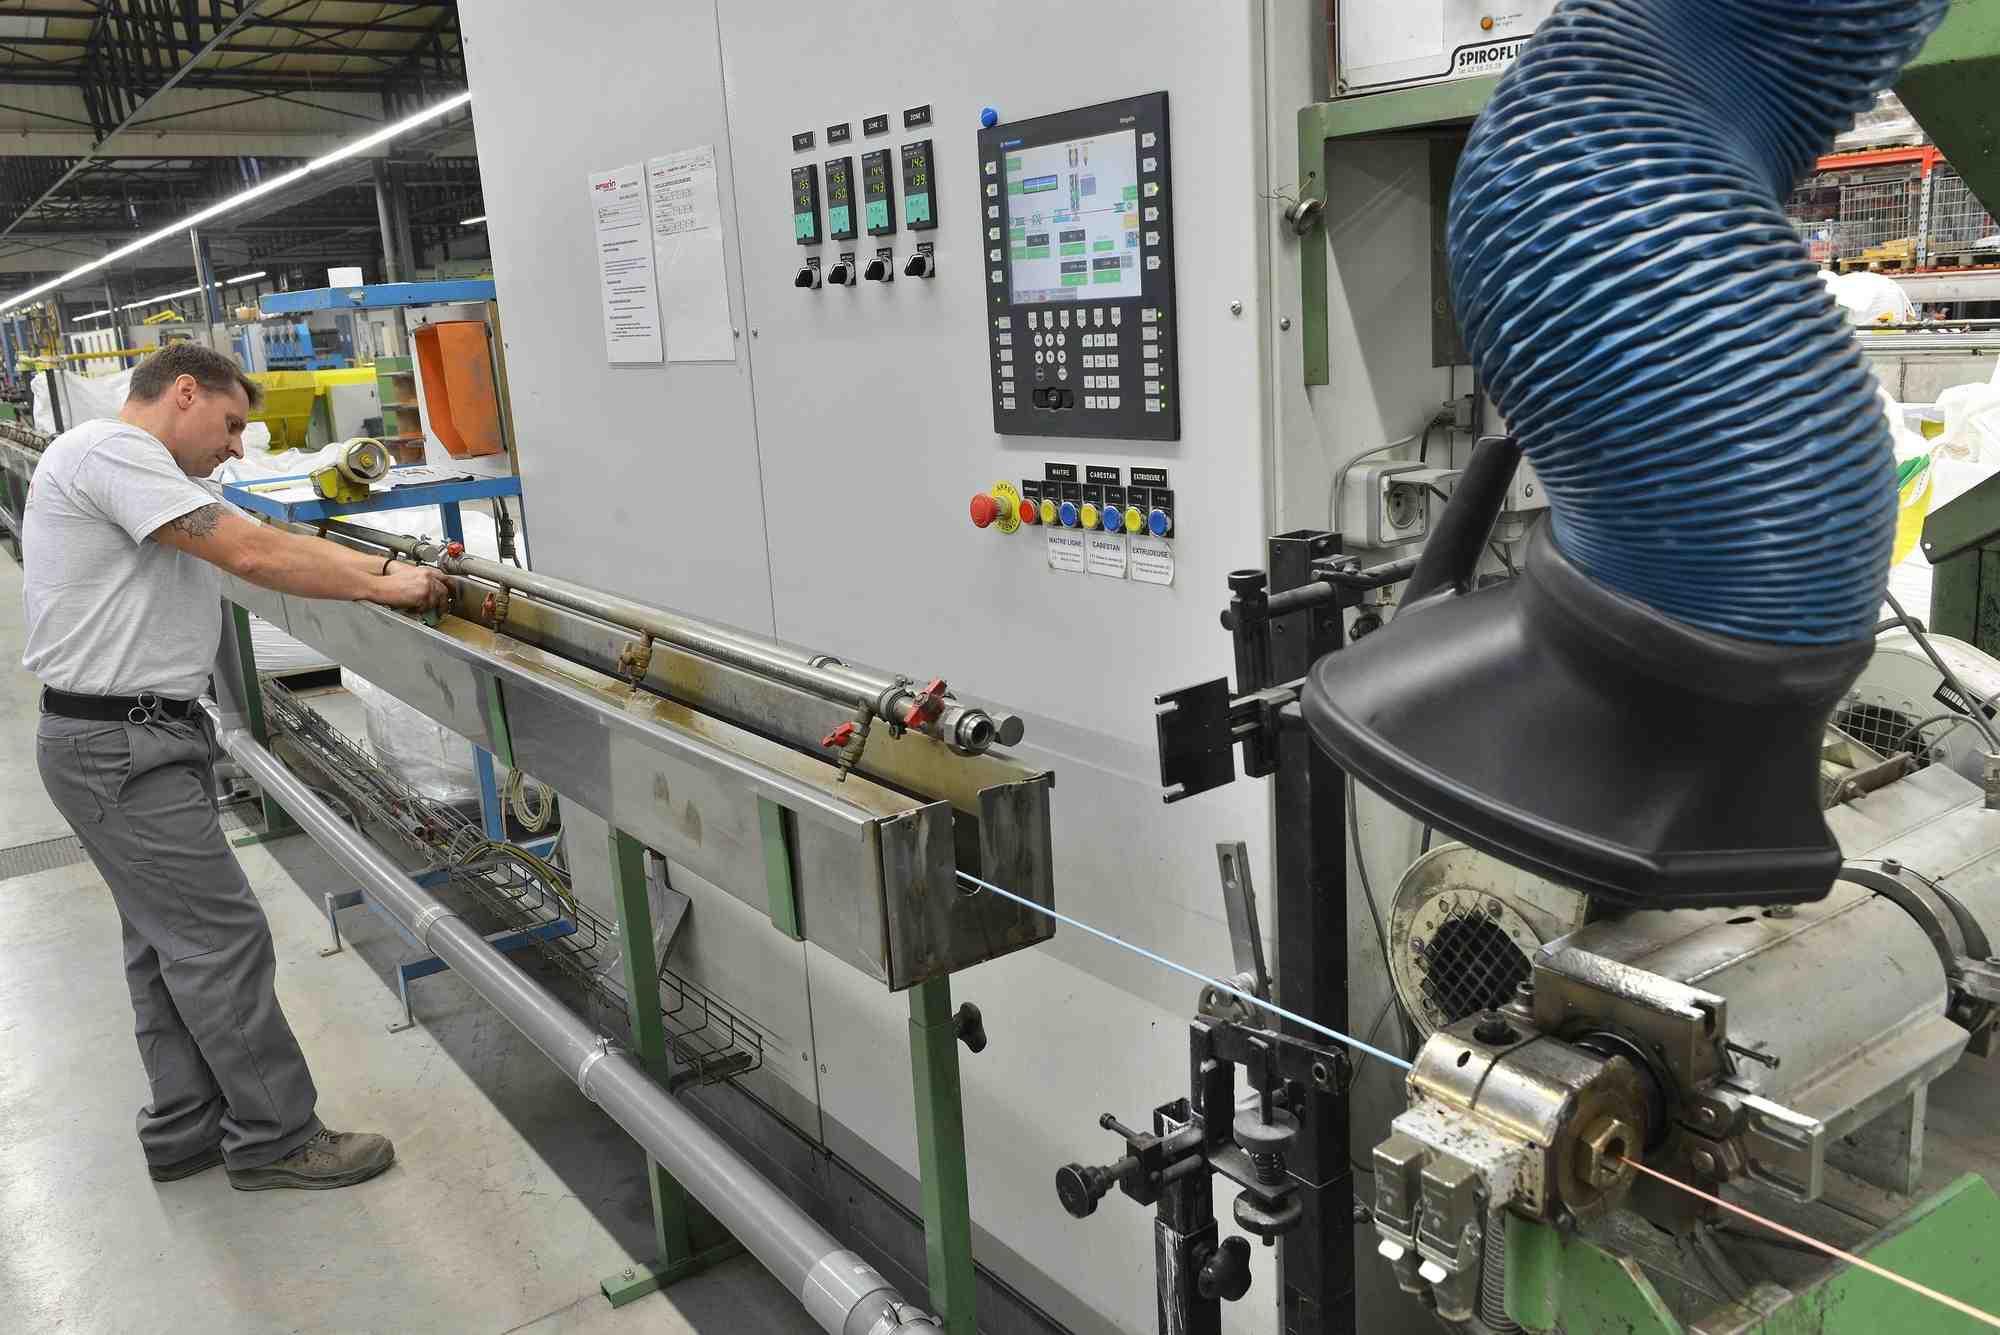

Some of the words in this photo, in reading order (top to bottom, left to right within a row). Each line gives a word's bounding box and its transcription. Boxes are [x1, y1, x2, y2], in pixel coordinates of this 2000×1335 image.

[1089, 471, 1116, 480] CABESTAN
[1133, 473, 1160, 482] EXTRUDEUSE
[1092, 541, 1120, 551] CABESTAN
[1132, 547, 1169, 558] EXTRUDEUSE
